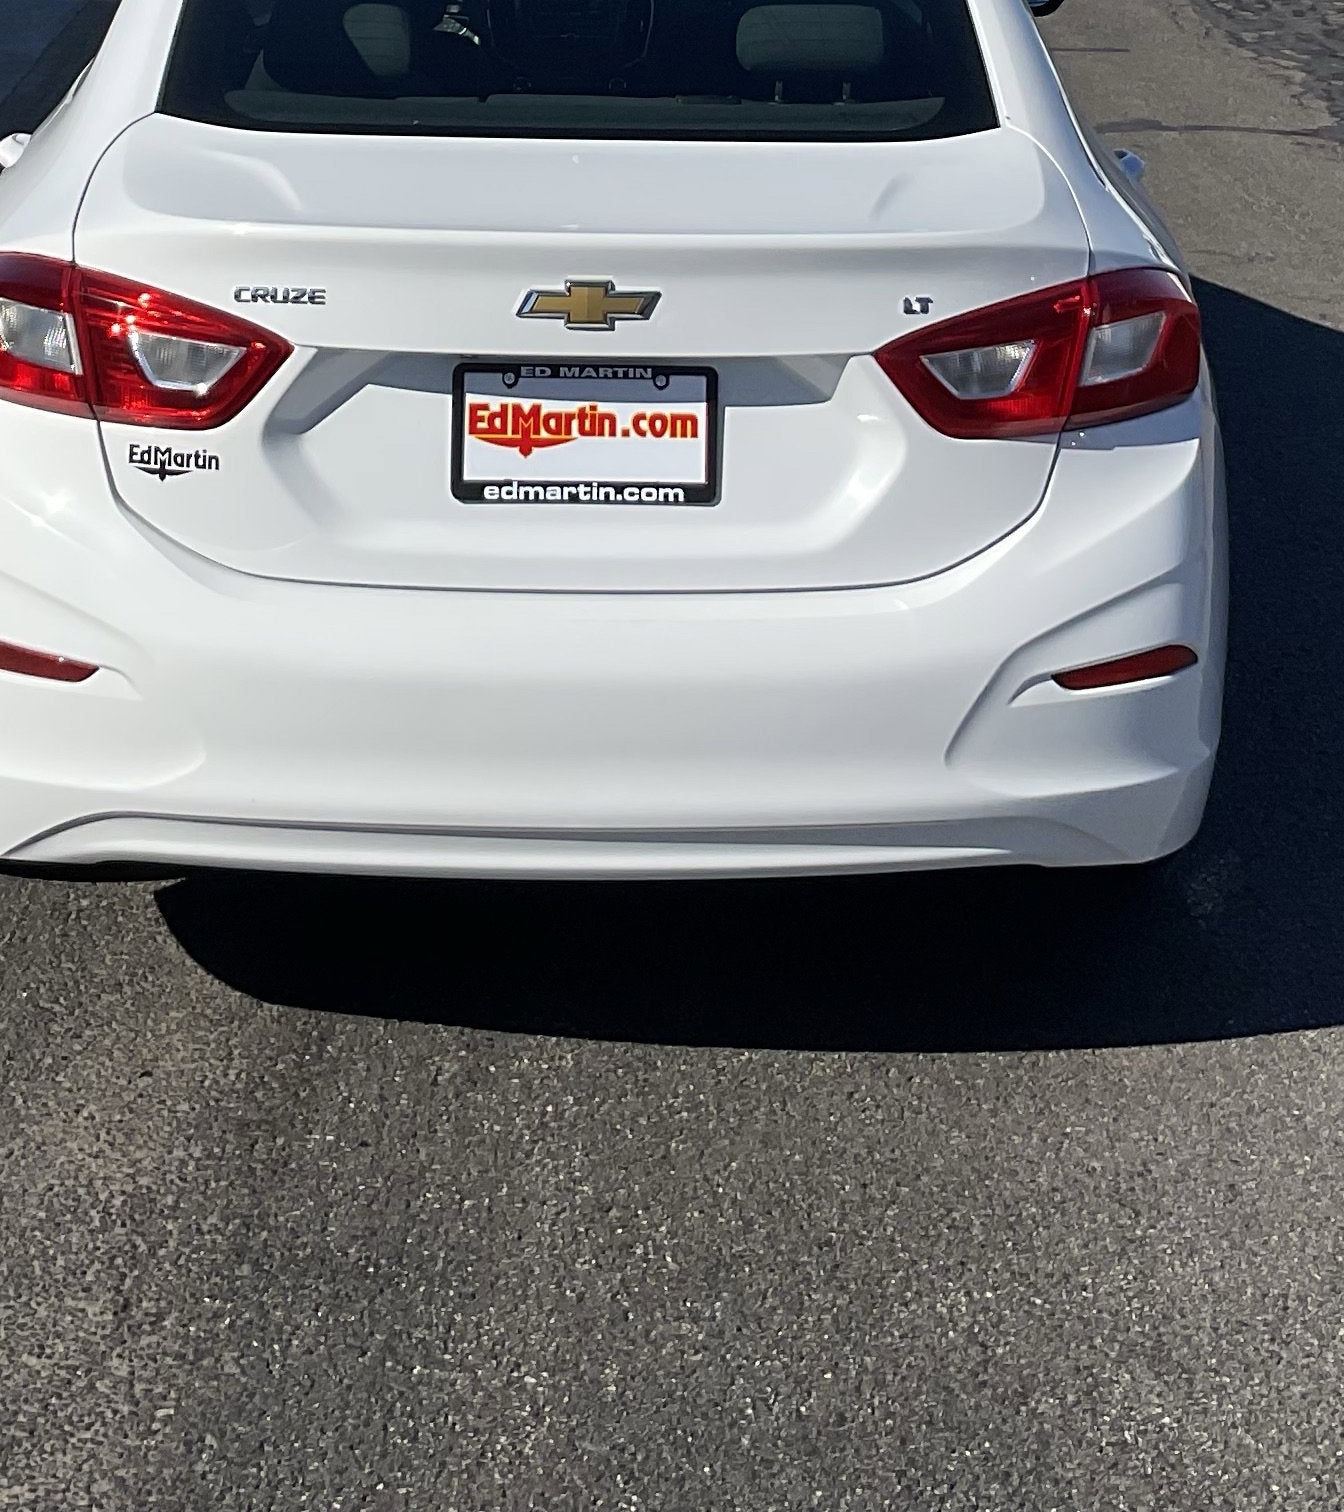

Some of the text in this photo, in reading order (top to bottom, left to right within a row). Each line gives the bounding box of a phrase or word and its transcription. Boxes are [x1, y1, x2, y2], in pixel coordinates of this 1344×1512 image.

[233, 285, 327, 305] CRUZE
[903, 297, 934, 315] LT
[520, 366, 653, 379] ED MARTIN
[483, 481, 685, 503] edmartin.com
